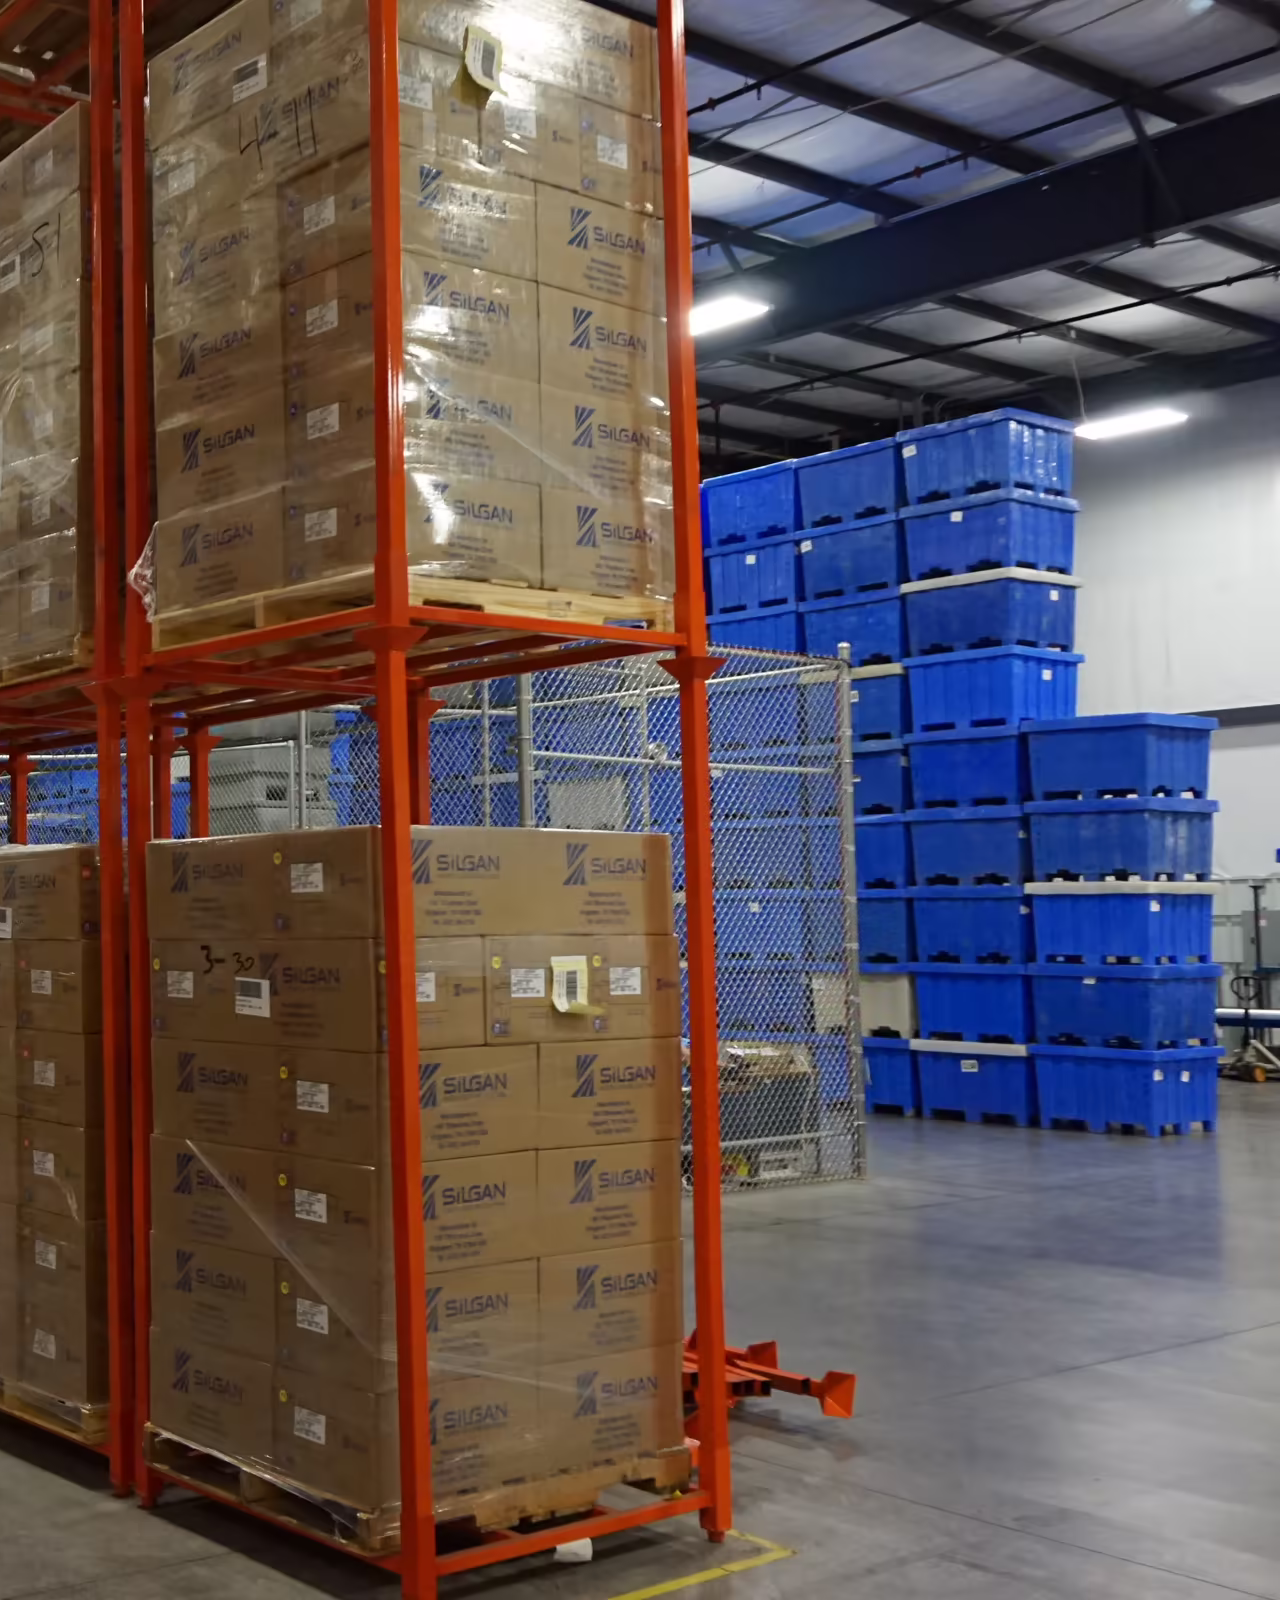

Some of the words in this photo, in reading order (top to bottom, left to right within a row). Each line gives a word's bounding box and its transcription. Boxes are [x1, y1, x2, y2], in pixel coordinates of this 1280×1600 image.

[593, 226, 646, 255] SILGAN
[449, 291, 510, 321] SILGAN
[199, 328, 252, 358] SILGAN
[595, 326, 647, 353] SILGAN
[202, 423, 255, 453] SILGAN
[598, 423, 650, 449] SILGAN
[454, 499, 513, 524] SILGAN
[201, 522, 254, 550] SILGAN
[600, 521, 653, 544] SILGAN
[436, 854, 501, 872] SILGAN
[591, 858, 646, 875] SILGAN
[282, 966, 341, 985] SILGAN
[198, 1066, 249, 1088] SILGAN
[443, 1073, 508, 1095] SILGAN
[599, 1065, 656, 1084] SILGAN
[598, 1167, 656, 1189] SILGAN
[442, 1181, 507, 1206] SILGAN
[195, 1268, 247, 1296] SILGAN
[600, 1271, 658, 1294] SILGAN
[444, 1292, 509, 1318] SILGAN
[600, 1376, 659, 1399] SILGAN
[443, 1402, 508, 1430] SILGAN
